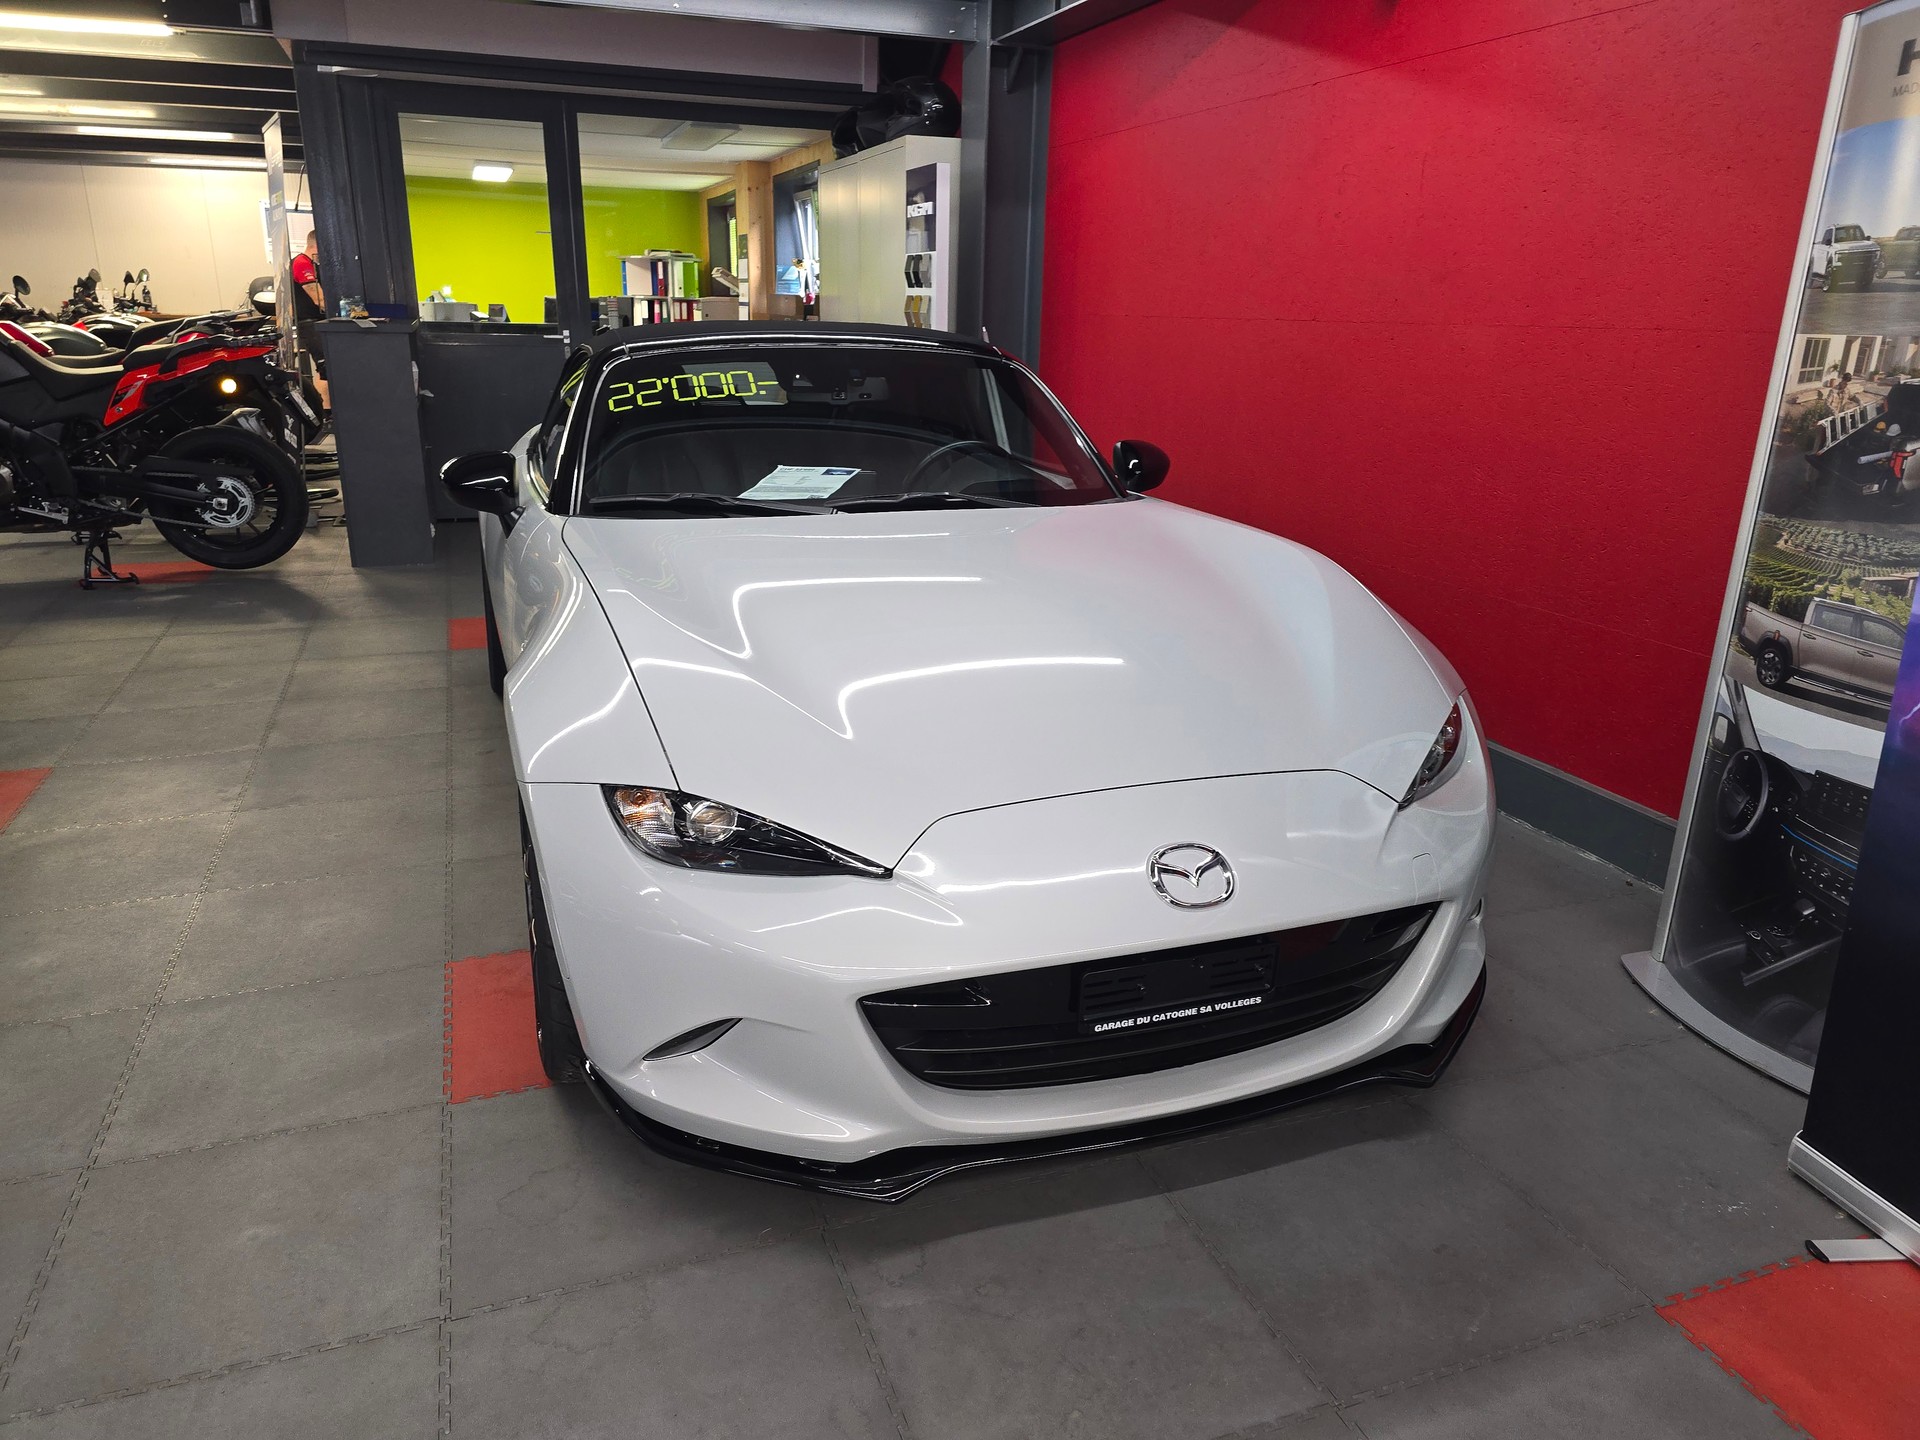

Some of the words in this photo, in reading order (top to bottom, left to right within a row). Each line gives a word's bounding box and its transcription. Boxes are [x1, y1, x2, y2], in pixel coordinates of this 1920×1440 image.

[906, 201, 934, 218] KGM
[1094, 1018, 1135, 1032] GARAGE
[1136, 1015, 1151, 1025] DU
[1152, 1007, 1198, 1022] CATOGNE
[1199, 1005, 1213, 1014] SA
[1214, 996, 1262, 1011] VOLLEGES
